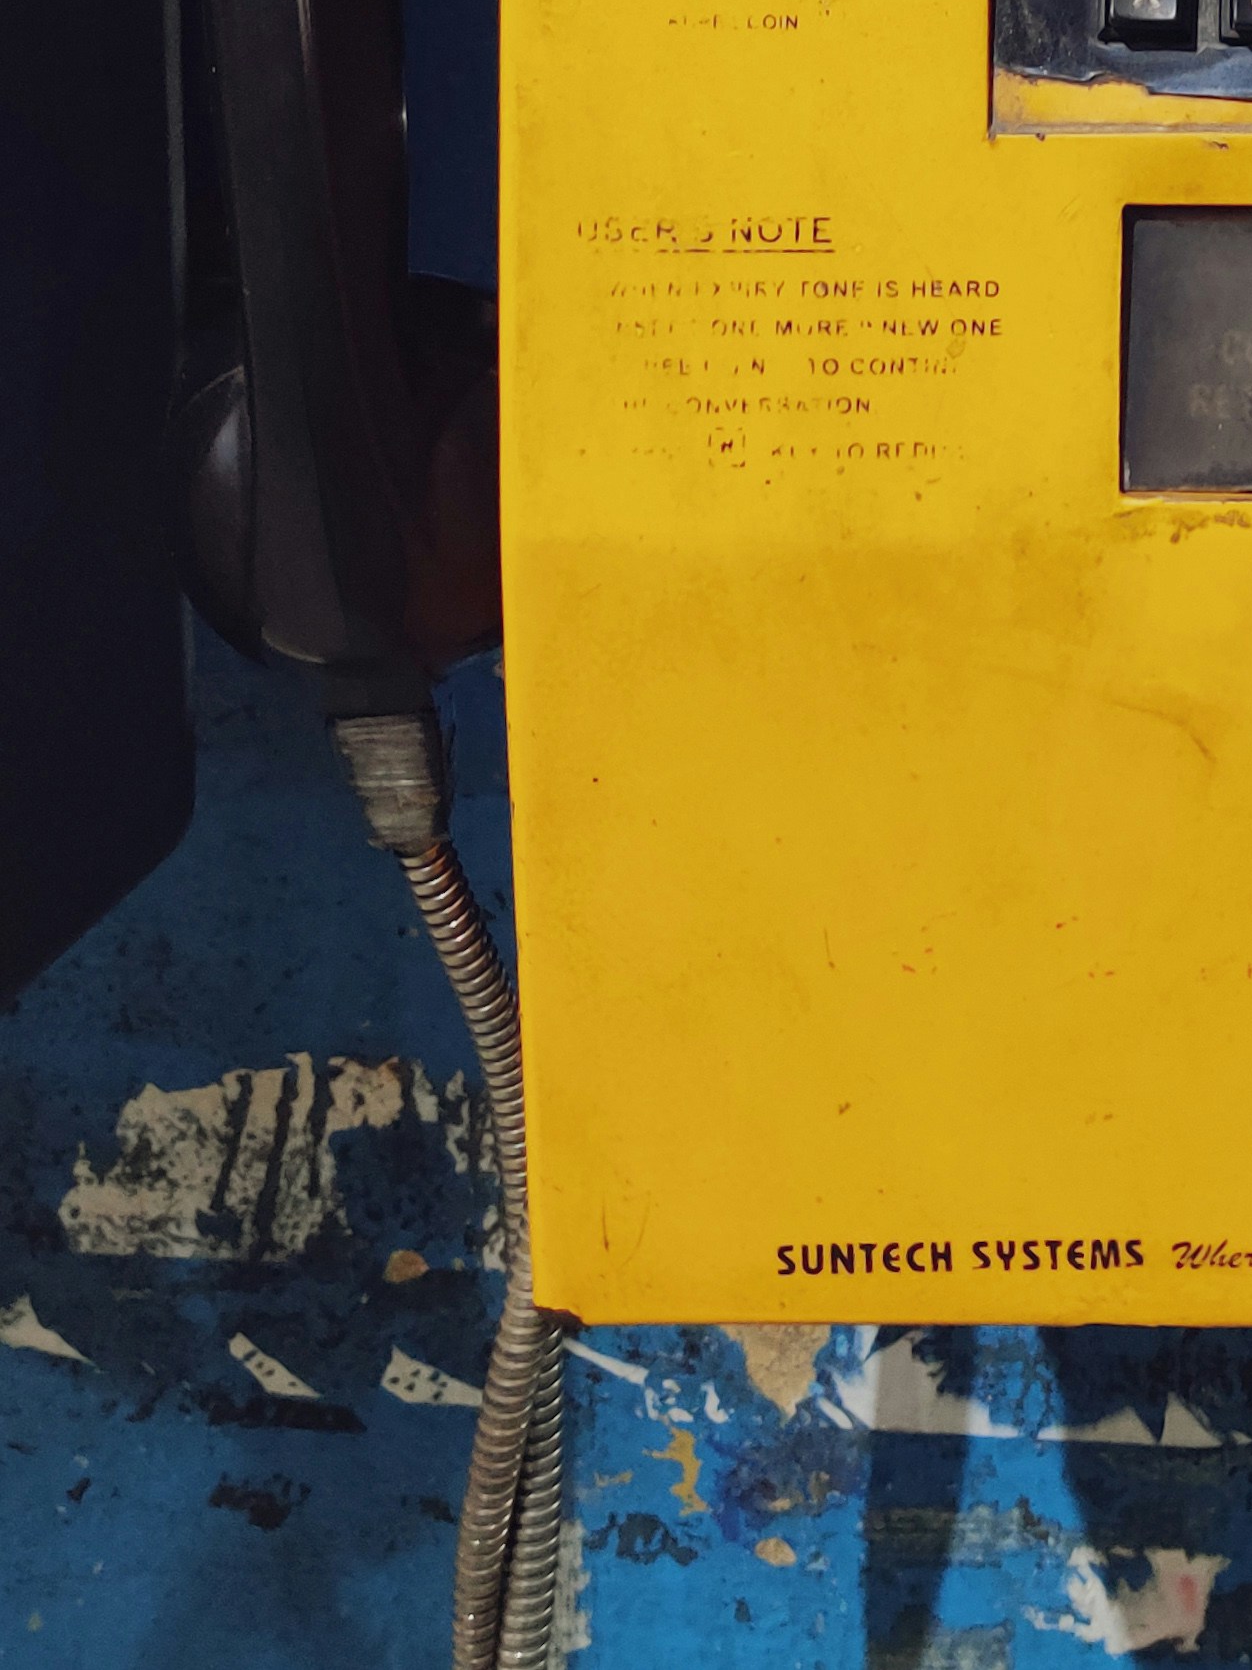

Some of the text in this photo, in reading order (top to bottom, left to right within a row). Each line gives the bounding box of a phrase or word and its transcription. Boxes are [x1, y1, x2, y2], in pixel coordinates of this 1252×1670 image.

[731, 217, 832, 243] NOTE
[802, 281, 865, 297] TONE
[877, 281, 899, 298] IS
[911, 281, 1000, 297] HEARD
[950, 319, 1002, 336] ONE
[777, 1243, 953, 1274] SUNTECH
[972, 1239, 1144, 1271] SYSTEMS
